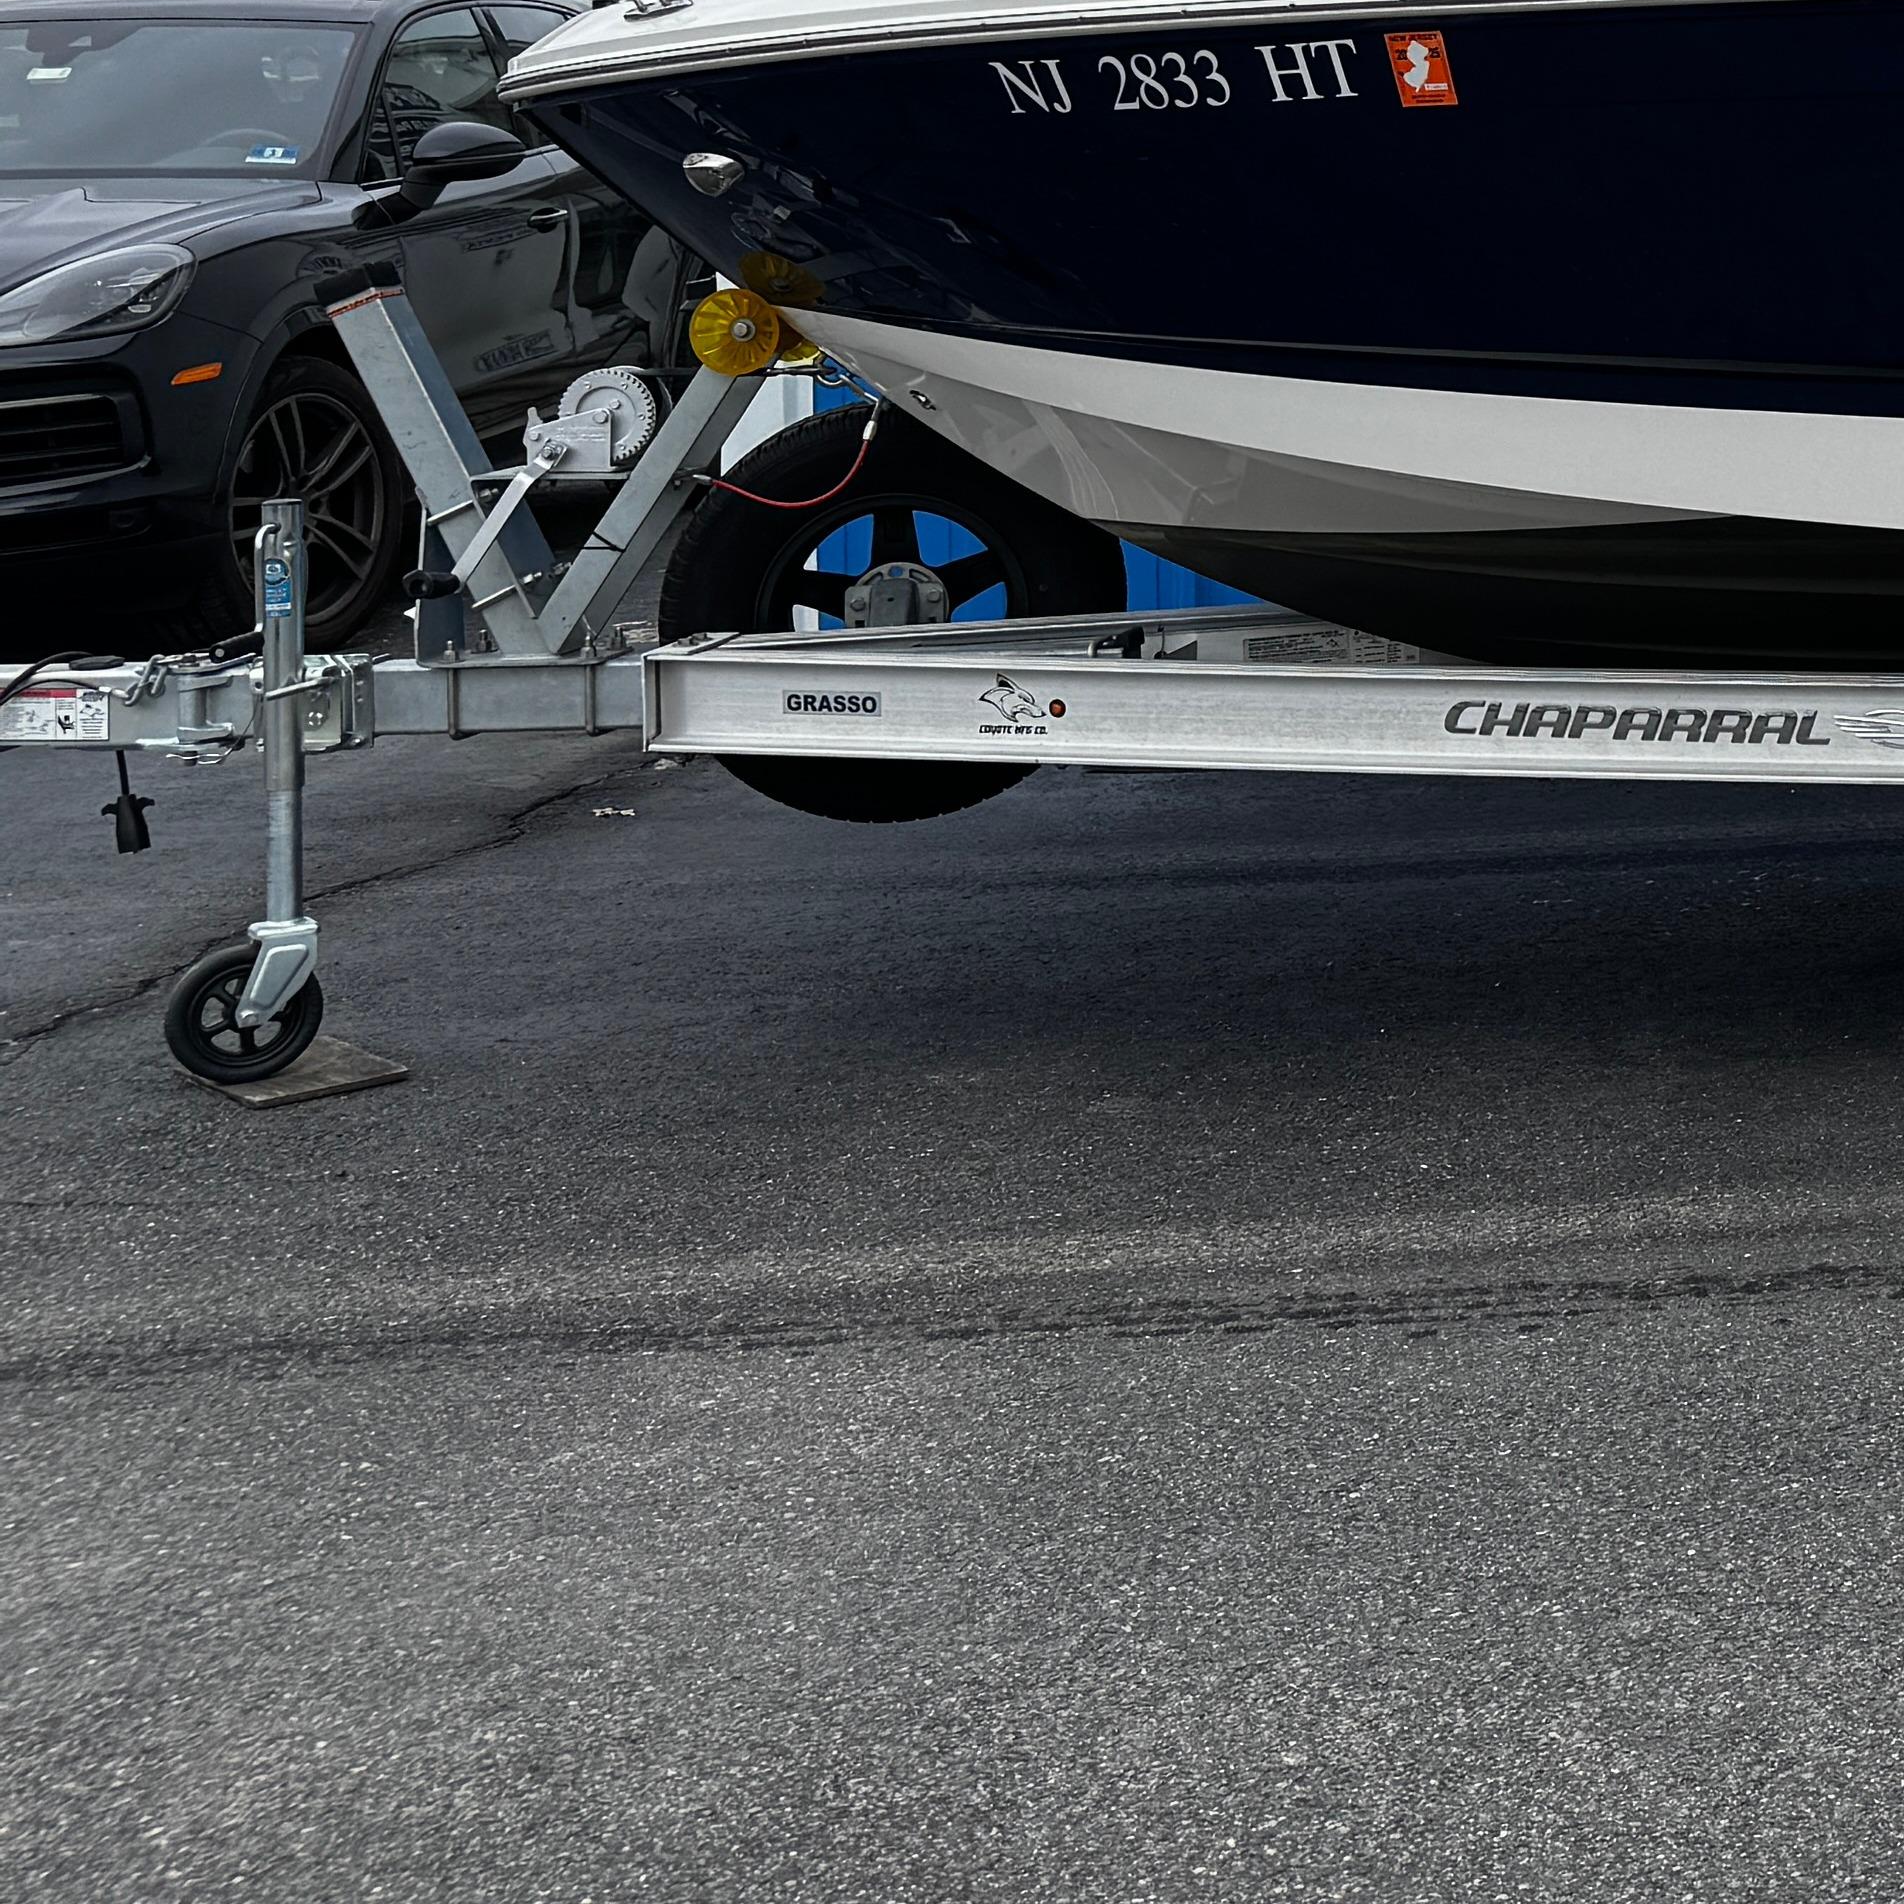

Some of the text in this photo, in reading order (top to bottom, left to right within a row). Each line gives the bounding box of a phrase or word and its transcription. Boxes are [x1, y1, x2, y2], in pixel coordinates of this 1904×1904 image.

[989, 39, 1359, 114] NJ 2833 HT
[786, 693, 877, 714] GRASSO
[1444, 700, 1831, 746] CHAPARRAL
